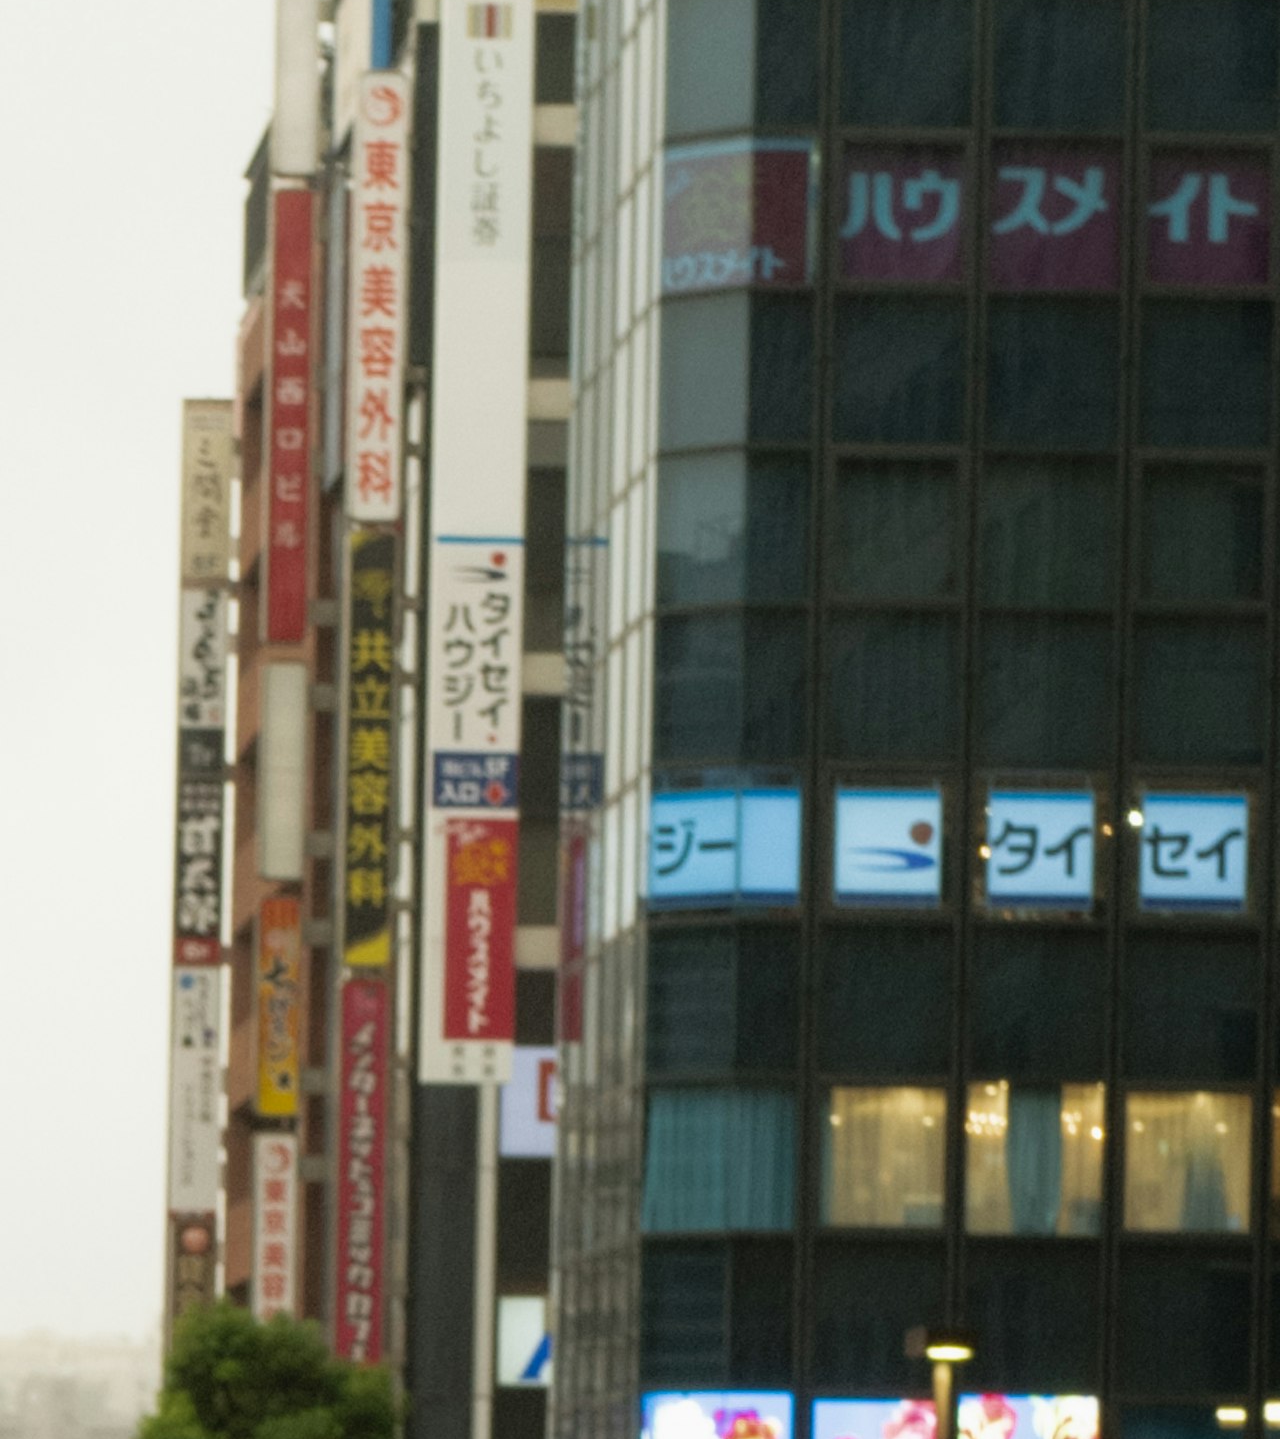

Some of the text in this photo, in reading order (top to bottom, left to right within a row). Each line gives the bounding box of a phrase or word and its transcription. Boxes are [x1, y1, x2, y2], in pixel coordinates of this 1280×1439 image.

[840, 166, 1260, 246] ハウスメイト
[357, 138, 400, 504] 東京美容外科
[443, 603, 476, 742] ハウジー
[479, 592, 510, 729] タイセイ
[347, 629, 391, 908] 共立美容外科
